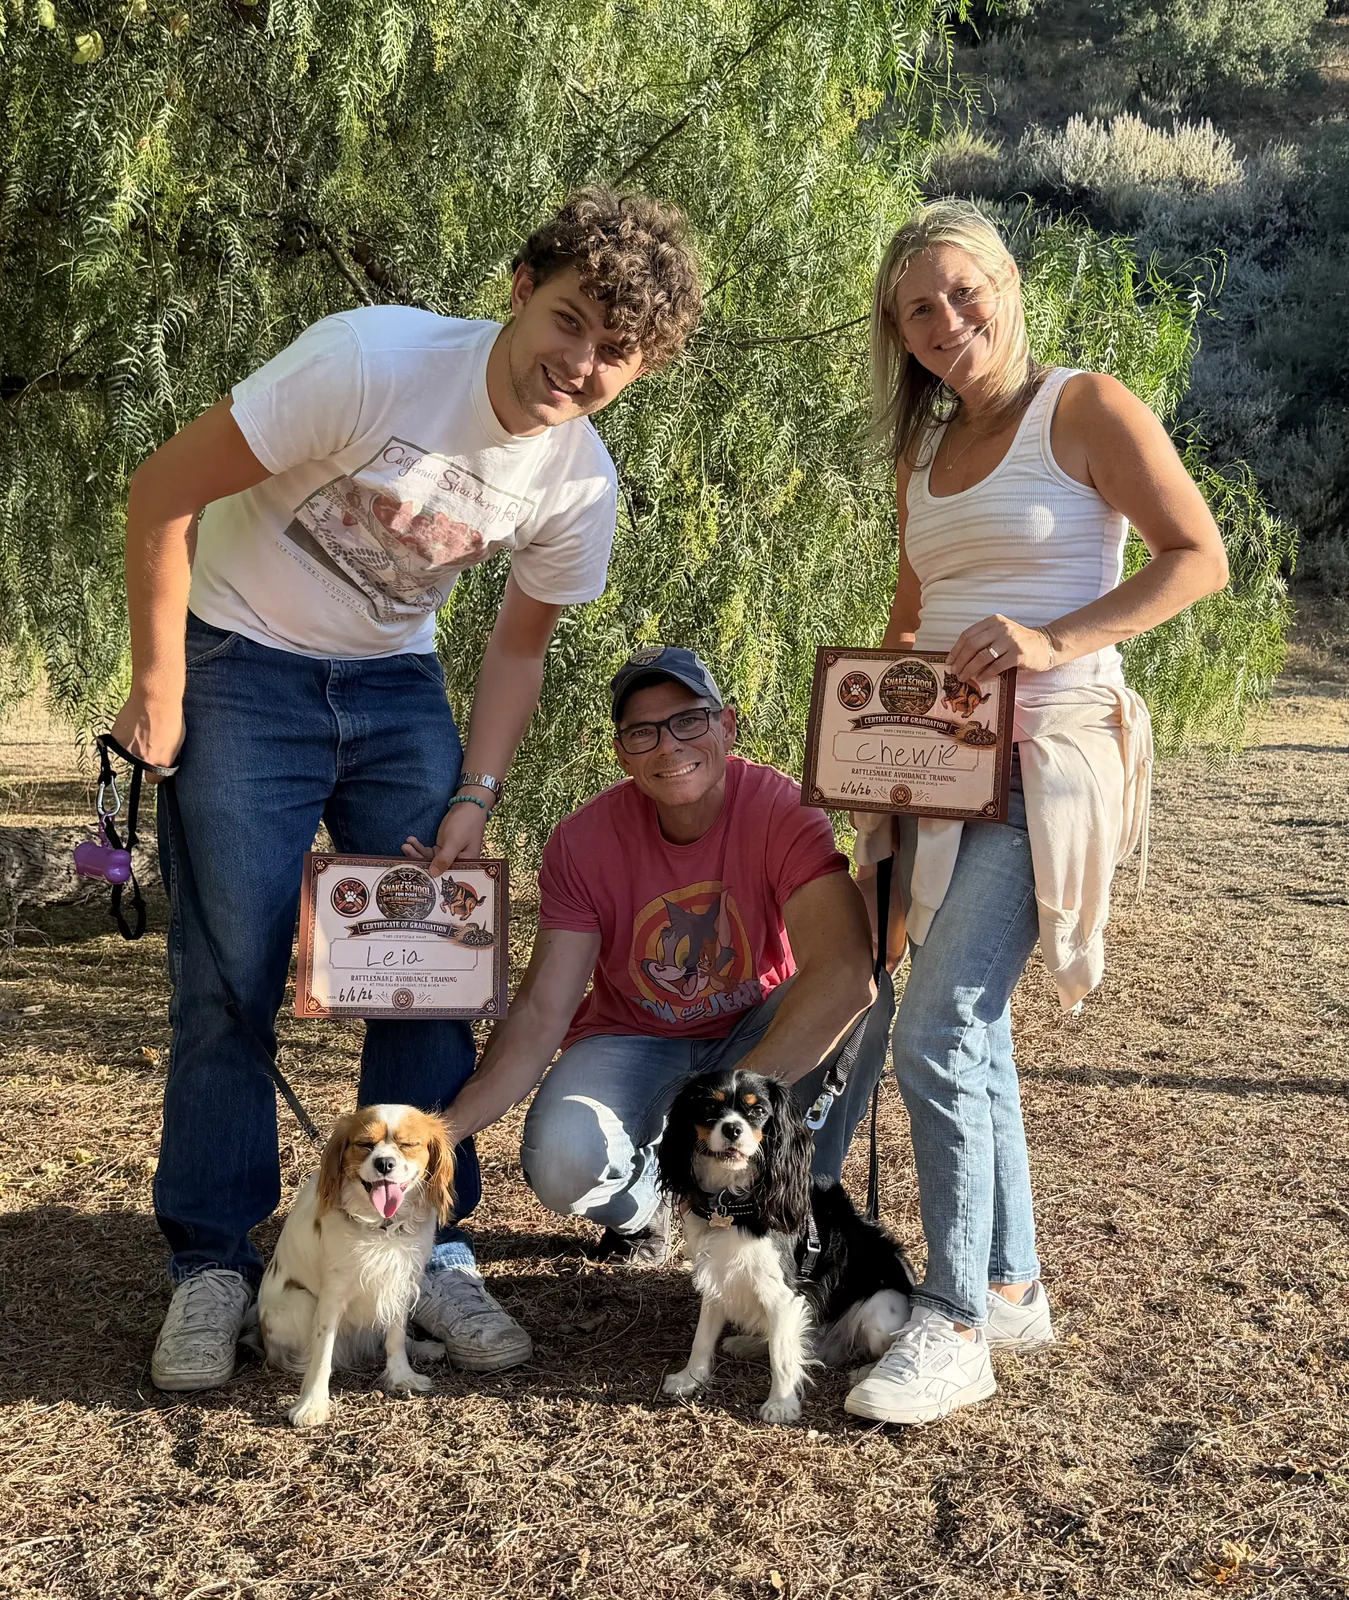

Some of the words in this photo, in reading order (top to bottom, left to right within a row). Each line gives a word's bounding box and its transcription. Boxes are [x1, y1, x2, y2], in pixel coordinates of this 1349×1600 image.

[383, 446, 438, 480] California
[884, 677, 907, 687] SNAKE
[907, 678, 934, 691] SCHOOL
[864, 715, 901, 725] CERTIFICATE
[901, 715, 909, 724] OF
[910, 716, 949, 730] GRADUATION
[851, 767, 893, 778] RATTLESNAKE
[893, 771, 927, 781] AVOIDANCE
[929, 774, 957, 783] TRAINING
[840, 780, 871, 796] 6/6/26
[381, 884, 404, 895] SNAKE
[404, 884, 431, 896] SCHOOL
[362, 920, 400, 931] CERTIFICATE
[400, 920, 409, 929] OF
[409, 920, 448, 933] GRADUATION
[366, 945, 425, 967] Leia
[350, 974, 394, 983] RATTLESNAKE
[394, 975, 429, 983] AVOIDANCE
[338, 986, 373, 1003] 6/6/26
[631, 996, 677, 1024] OM
[681, 998, 706, 1018] and
